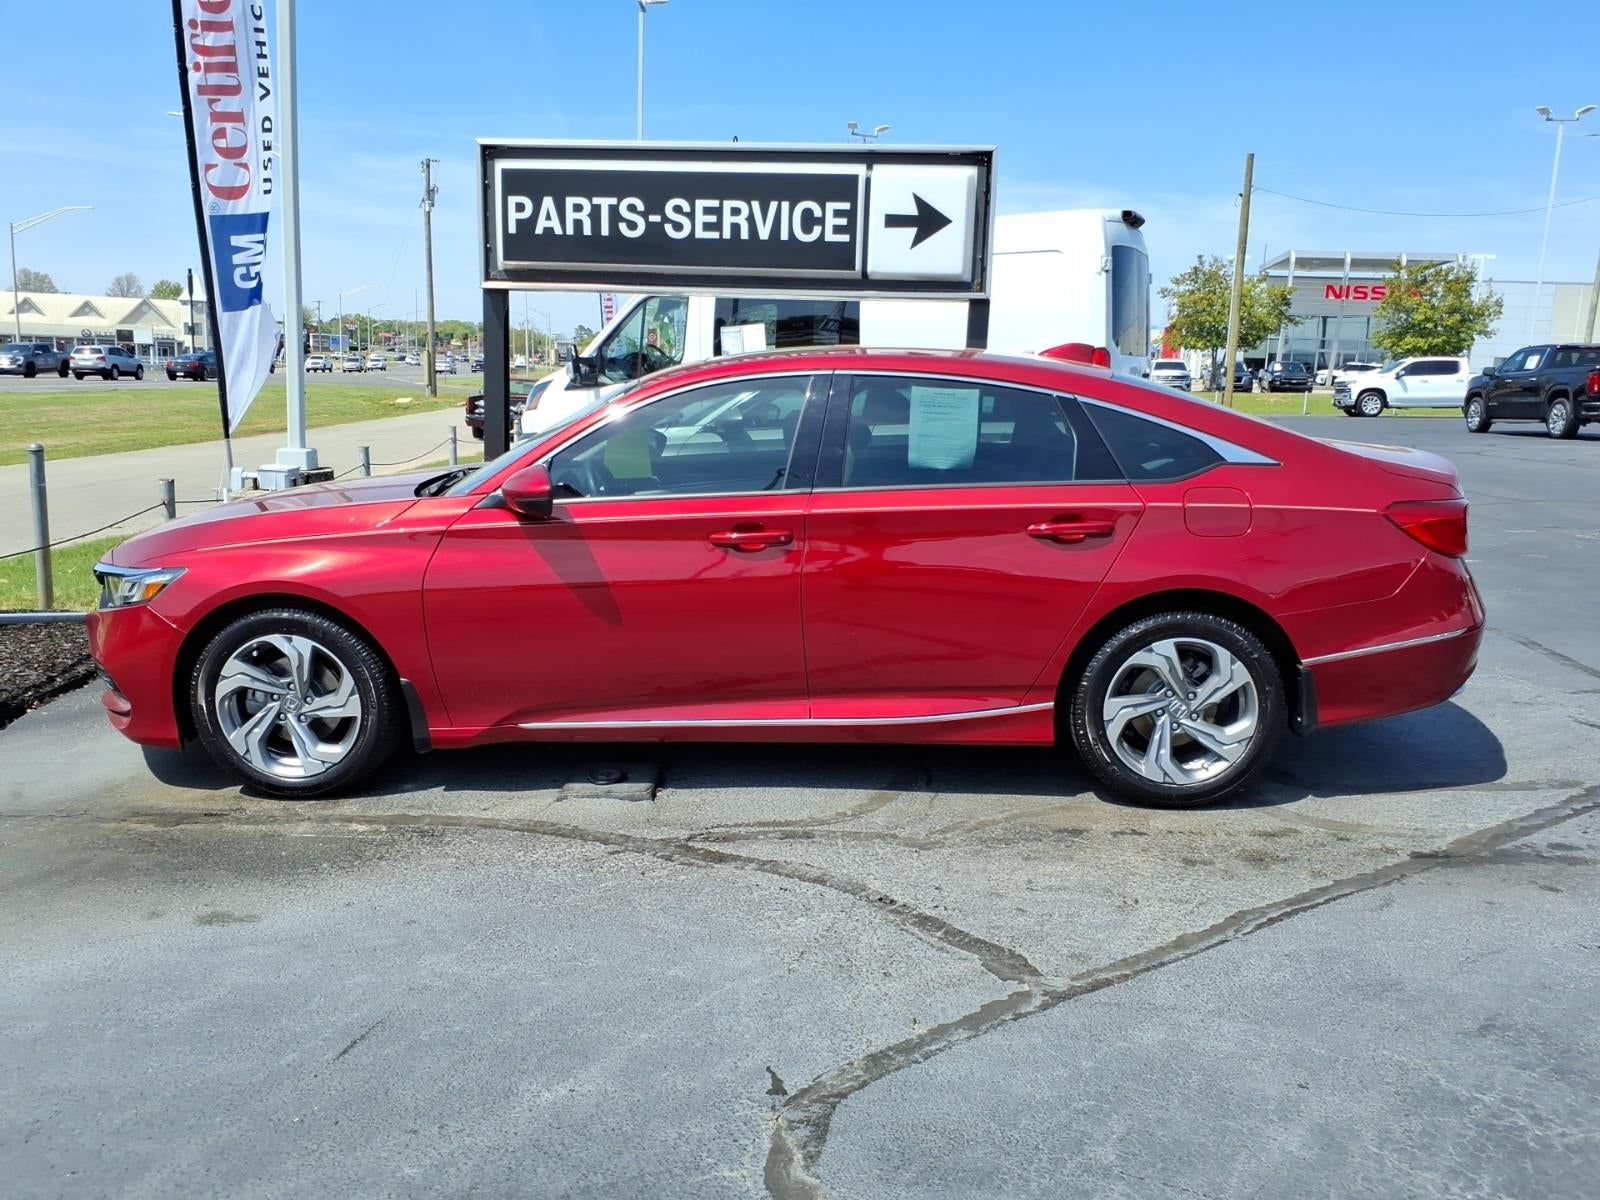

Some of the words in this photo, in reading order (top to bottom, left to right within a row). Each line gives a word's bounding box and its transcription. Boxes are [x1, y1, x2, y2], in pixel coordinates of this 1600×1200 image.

[251, 4, 271, 102] VEHIC
[261, 115, 273, 195] USED
[506, 195, 851, 243] PARTS-SERVICE
[230, 233, 266, 289] GM
[1325, 284, 1422, 300] NISS
